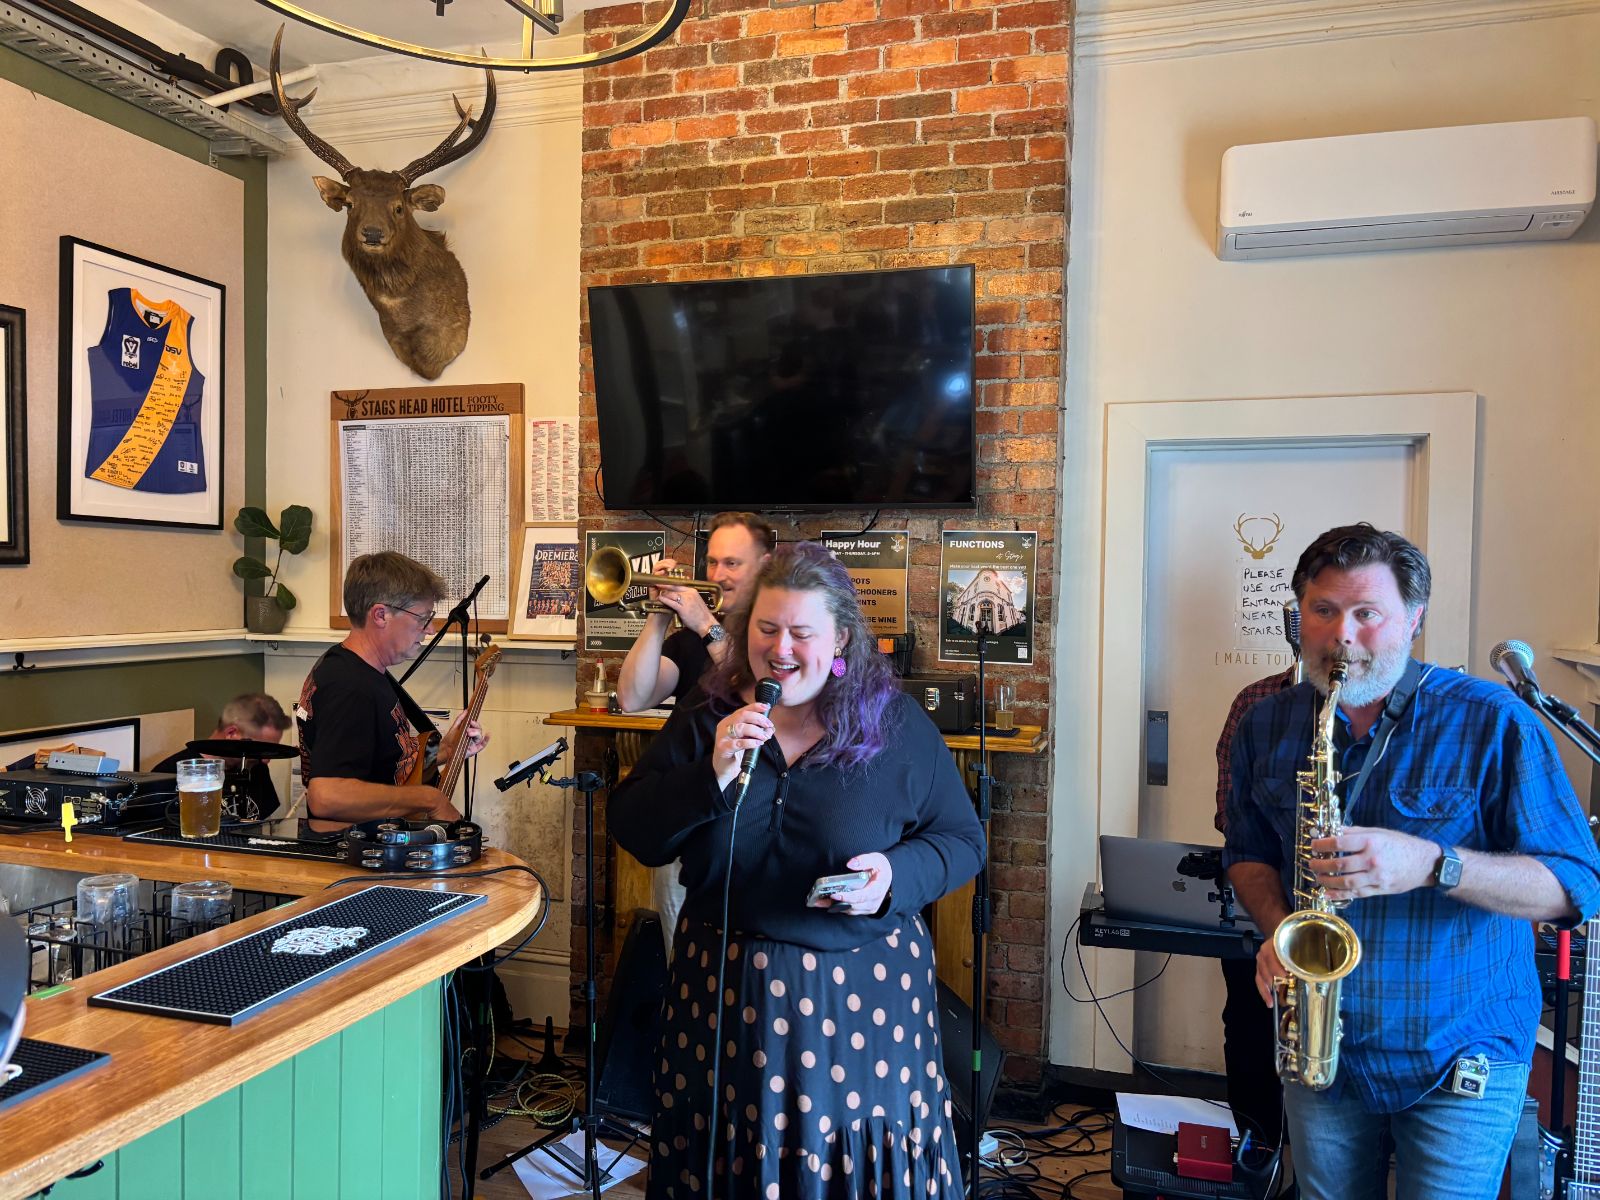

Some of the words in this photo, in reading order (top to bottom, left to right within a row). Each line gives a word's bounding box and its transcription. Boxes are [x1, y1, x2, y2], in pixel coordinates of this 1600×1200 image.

[166, 345, 182, 355] DSV
[122, 360, 138, 369] rebel
[467, 394, 498, 405] FOOTY
[362, 400, 396, 416] STAGS
[399, 398, 428, 415] HEAD
[431, 396, 466, 414] HOTEL
[466, 403, 504, 413] TIPPING
[825, 539, 856, 550] Happy
[857, 539, 882, 549] Hour
[949, 540, 1005, 549] FUNCTIONS
[1244, 568, 1284, 579] PLEASE
[856, 588, 898, 596] CHOONERS
[1243, 583, 1263, 593] USE
[1270, 582, 1293, 593] OTH
[1242, 597, 1286, 608] ENTRAN
[878, 616, 897, 624] WINE
[1242, 610, 1277, 621] NEAR
[1241, 625, 1283, 636] STAIRS
[1224, 652, 1258, 664] MALE
